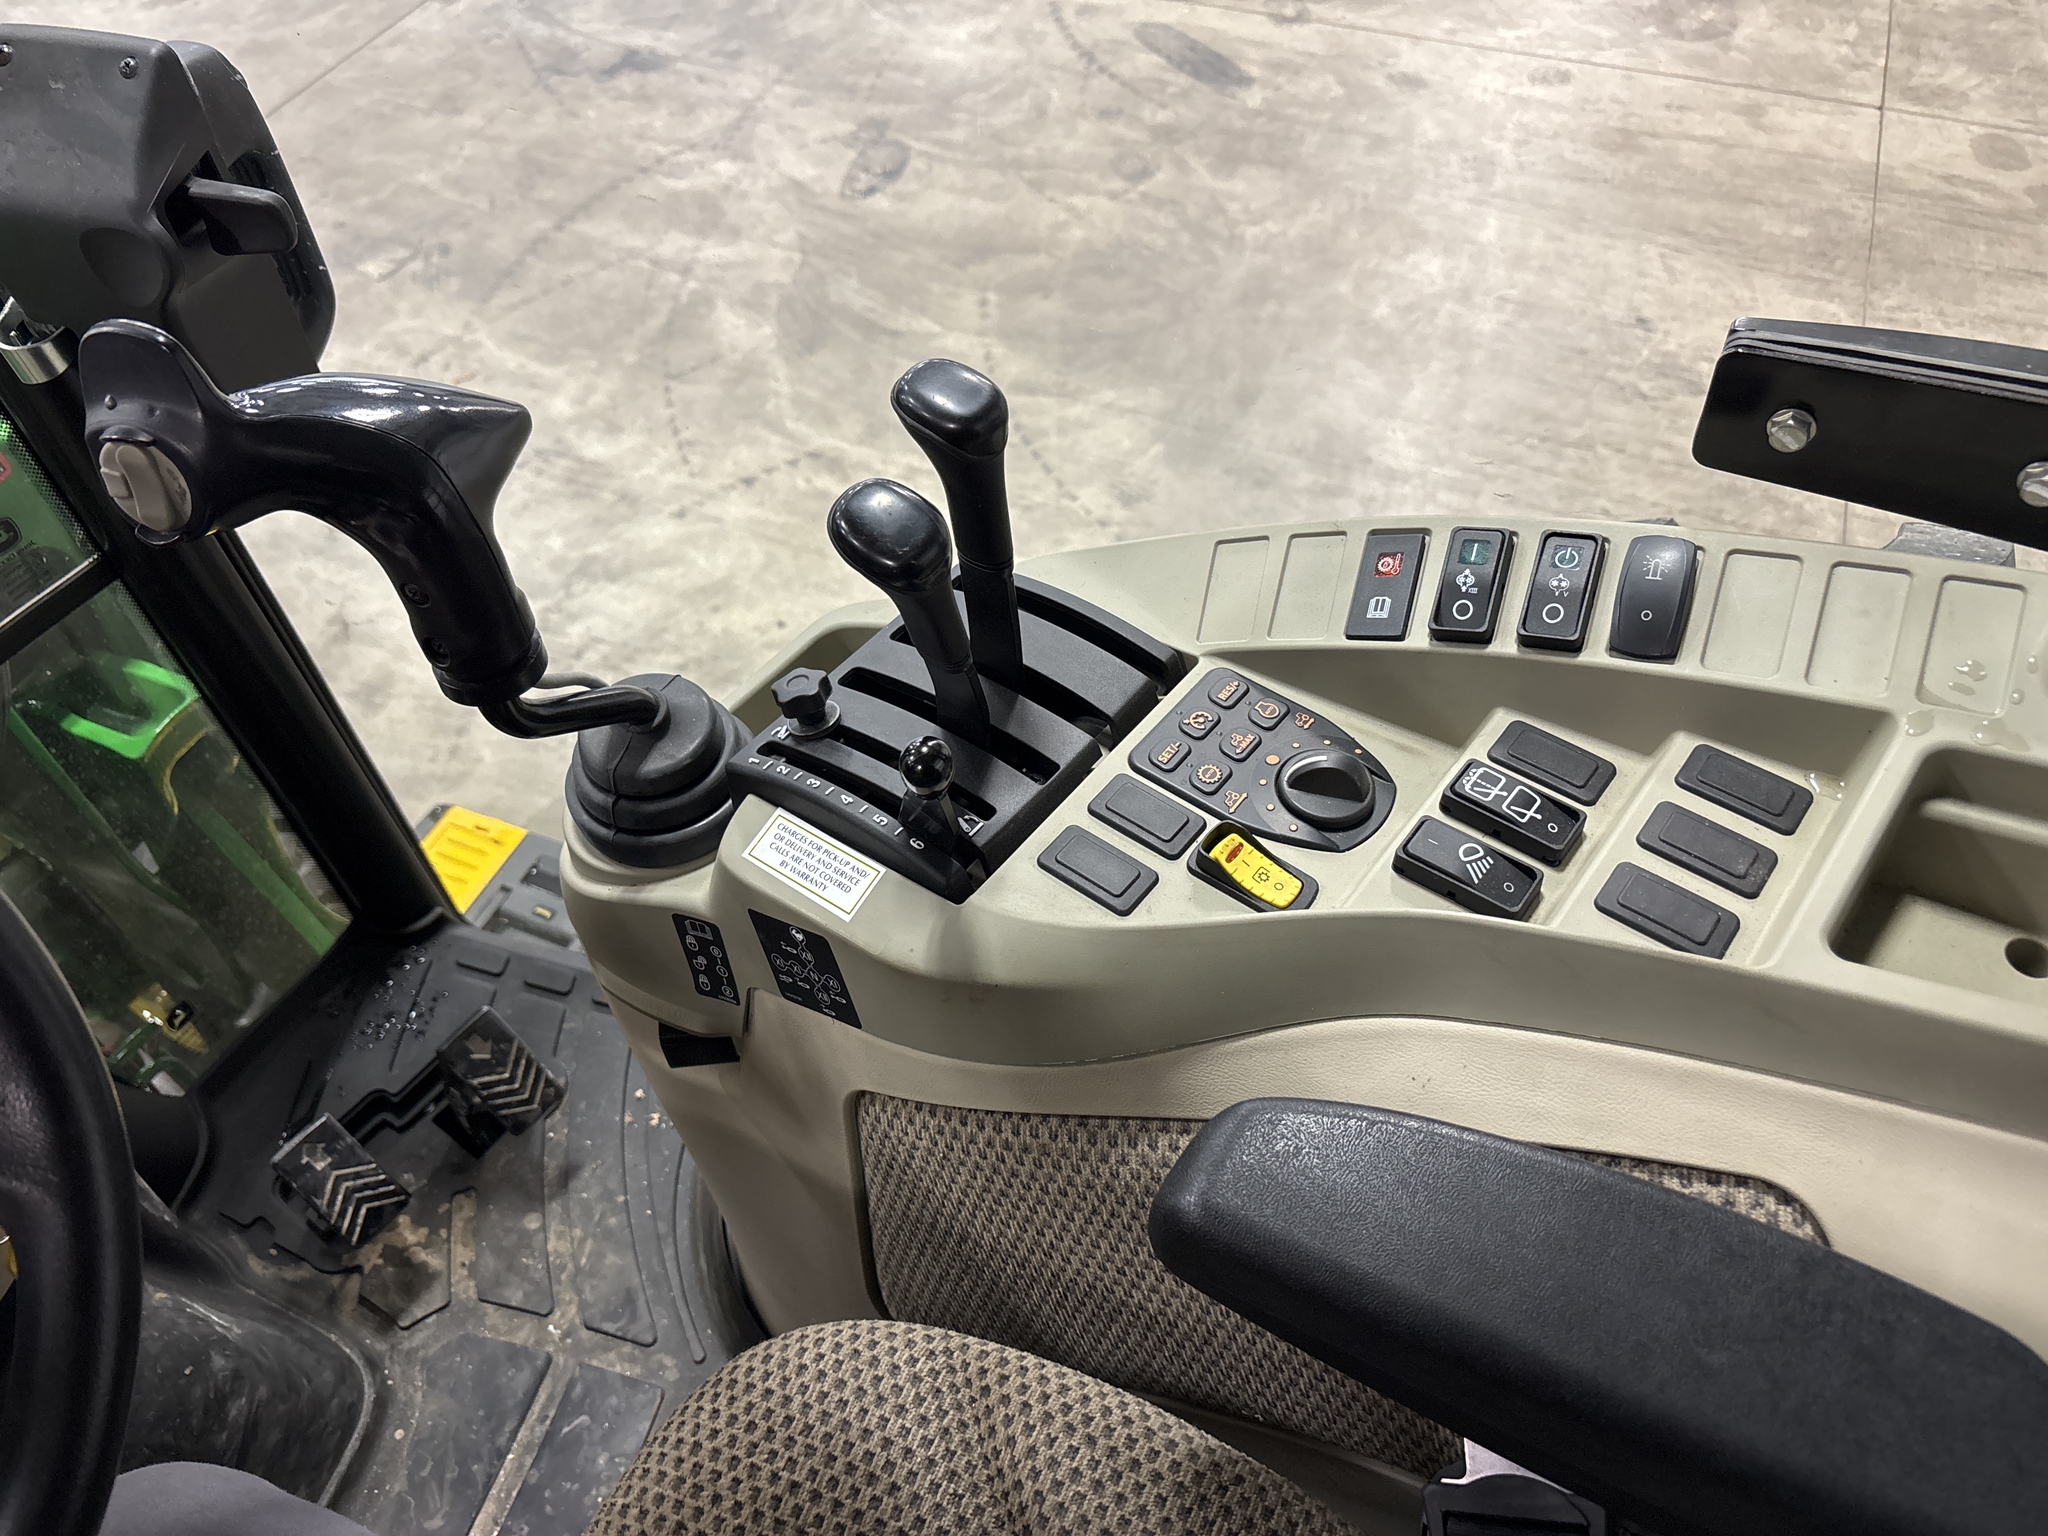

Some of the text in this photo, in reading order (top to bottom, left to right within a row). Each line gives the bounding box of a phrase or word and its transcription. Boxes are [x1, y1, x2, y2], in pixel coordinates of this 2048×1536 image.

[1240, 733, 1256, 749] MAX
[776, 765, 791, 774] 2
[806, 778, 821, 788] 3
[840, 794, 854, 805] 4
[872, 814, 888, 826] 5
[909, 837, 925, 850] 6
[769, 842, 852, 893] CALLS ARE NOT COVERED
[773, 832, 861, 887] OR DELIVERY AND SERVICE
[777, 822, 871, 879] CHARGES FOR PICK-UP AND/
[779, 859, 829, 892] BY WARRANTY
